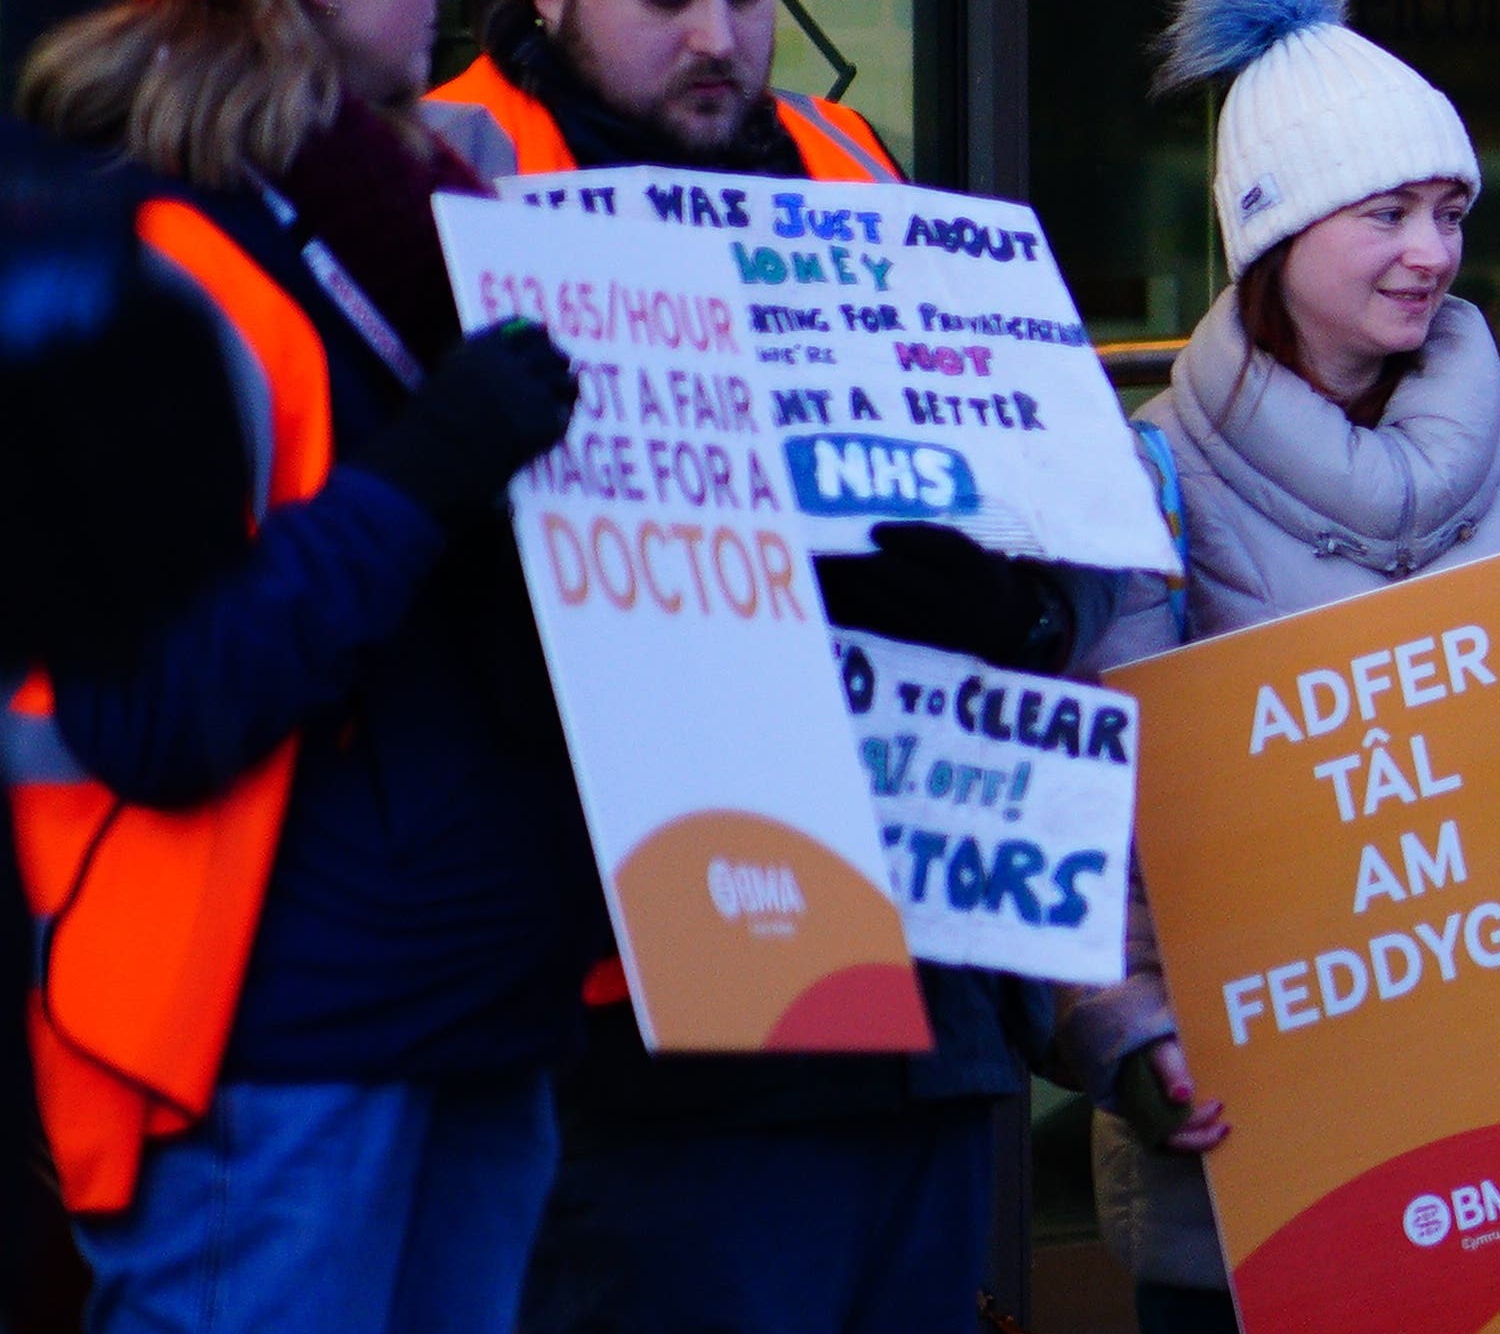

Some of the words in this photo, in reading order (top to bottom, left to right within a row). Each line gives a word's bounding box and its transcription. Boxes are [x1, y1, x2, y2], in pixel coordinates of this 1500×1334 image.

[643, 183, 751, 229] WAS
[772, 192, 882, 244] JUST
[904, 213, 1038, 262] ABOUT
[840, 303, 905, 333] FOR
[571, 359, 626, 422] OT
[638, 366, 667, 428] A
[666, 367, 759, 434] FAIR
[893, 341, 993, 377] NOT
[849, 385, 883, 421] A
[901, 386, 1046, 431] BETTER
[645, 438, 740, 510] FOR
[747, 447, 781, 513] A
[812, 439, 958, 508] NHS
[540, 508, 806, 622] DOCTOR
[896, 679, 947, 717] TO
[954, 673, 1130, 765] CLEAR
[1248, 623, 1499, 757] ADFER
[1312, 729, 1463, 824] TÂL
[884, 824, 1108, 930] TORS
[1351, 819, 1470, 916] AM
